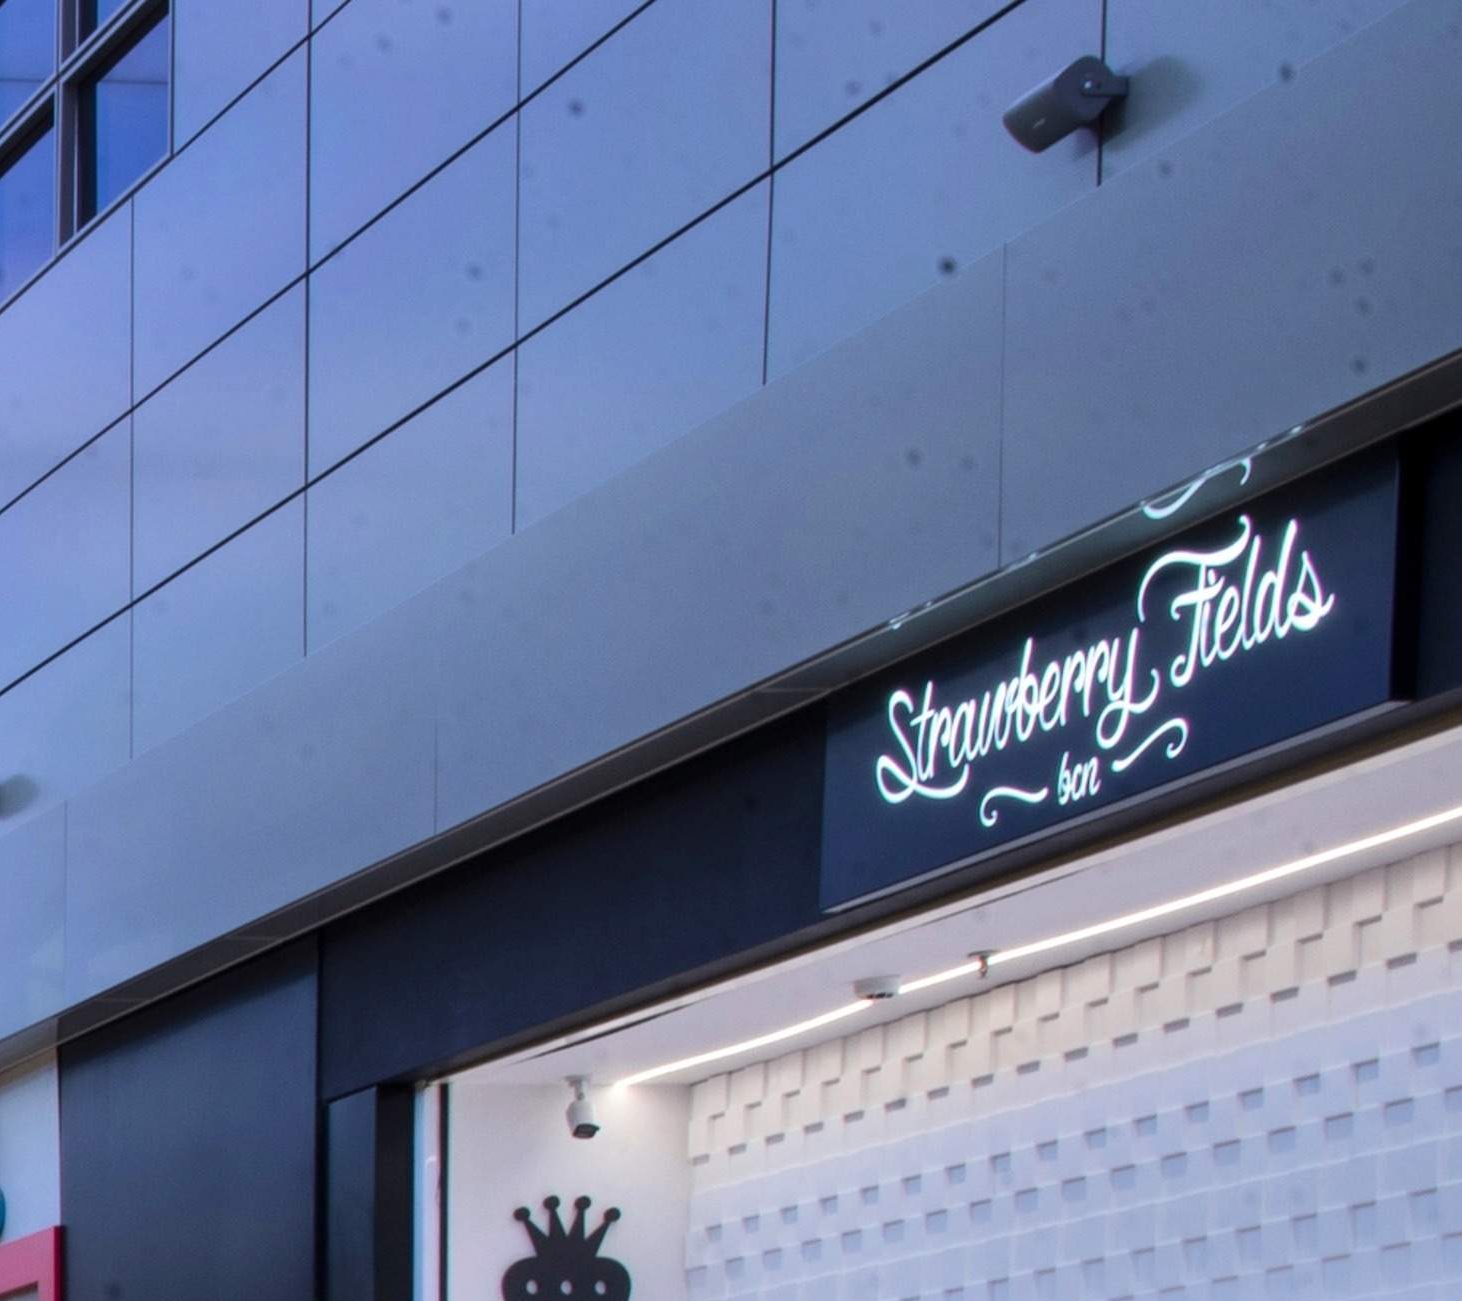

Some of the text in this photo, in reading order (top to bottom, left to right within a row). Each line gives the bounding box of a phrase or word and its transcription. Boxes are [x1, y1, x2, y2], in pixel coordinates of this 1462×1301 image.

[875, 513, 1335, 805] Strawberry Fields
[1057, 751, 1102, 806] bcn
